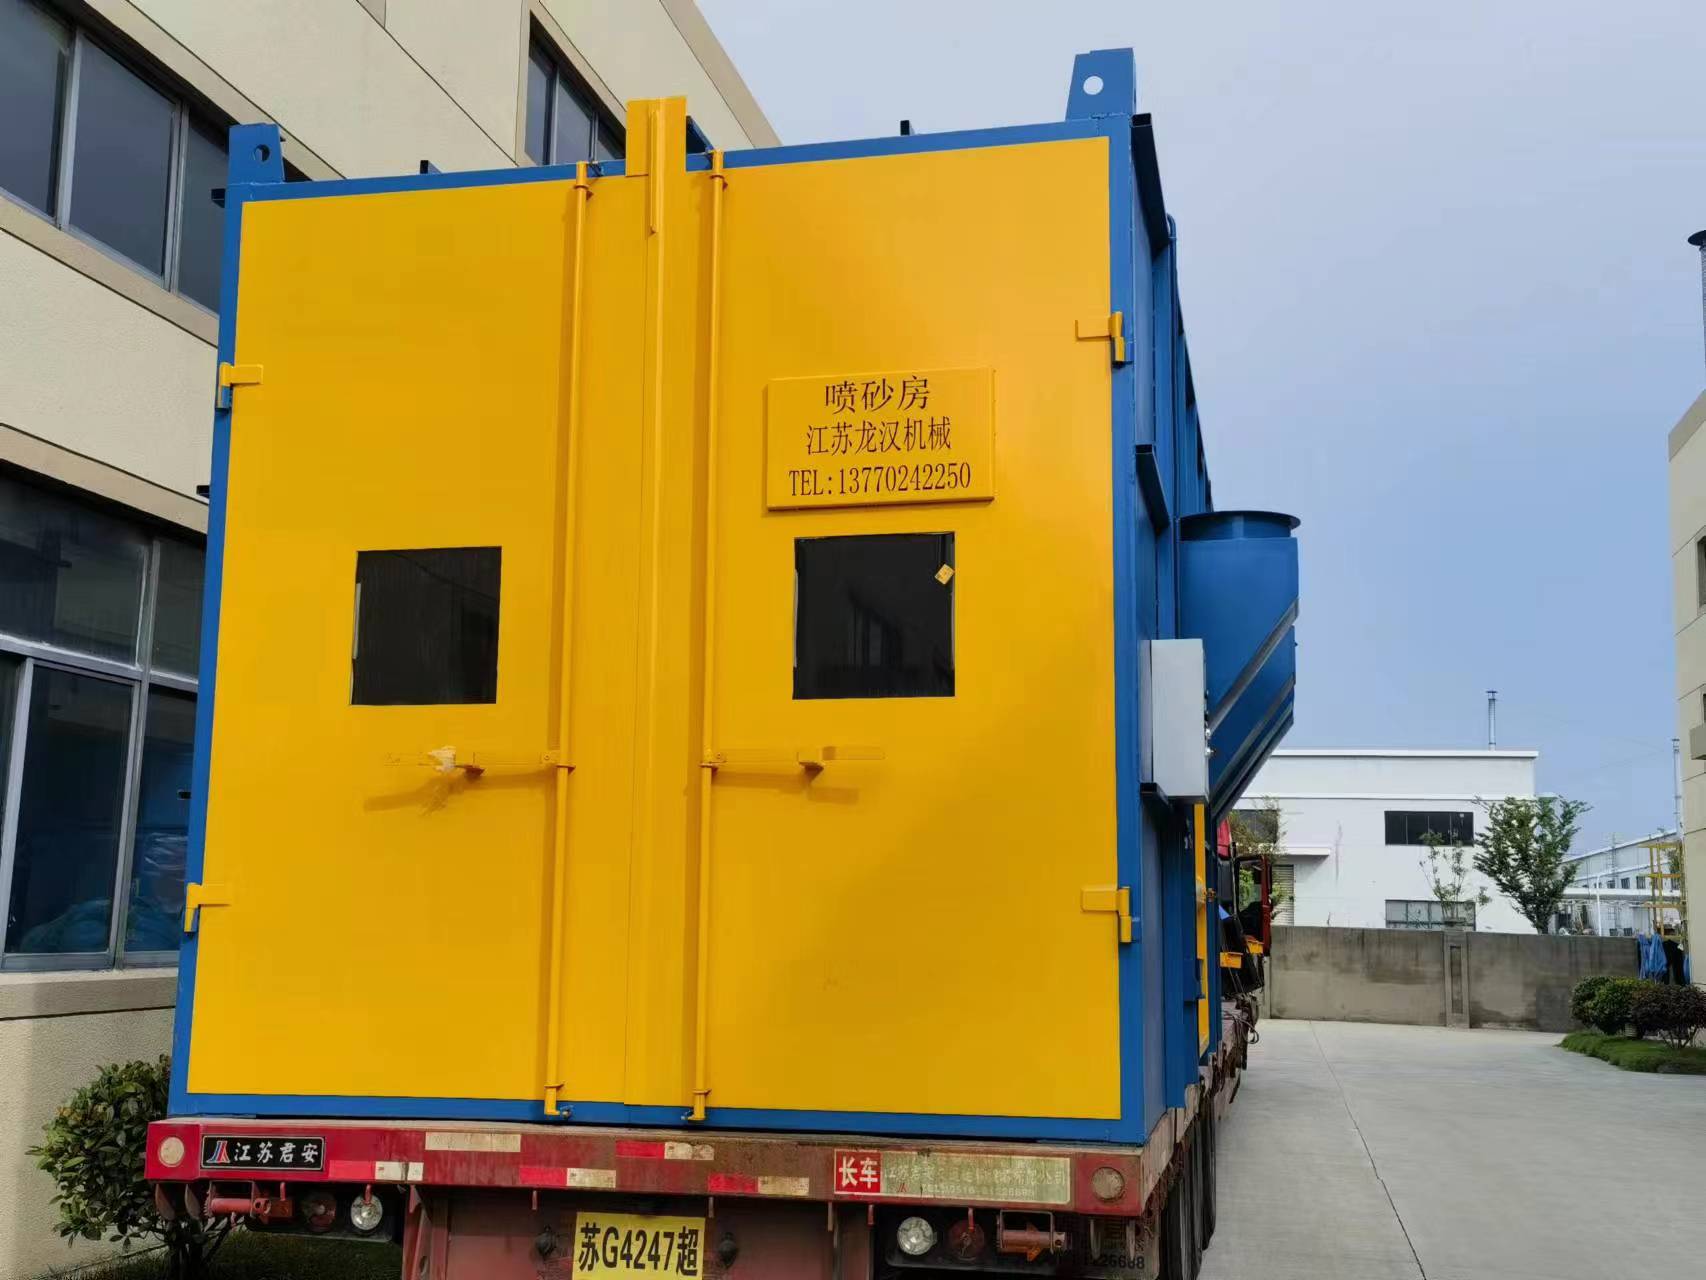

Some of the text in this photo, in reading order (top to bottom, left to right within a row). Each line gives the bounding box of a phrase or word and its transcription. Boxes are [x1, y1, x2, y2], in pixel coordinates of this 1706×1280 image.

[825, 375, 930, 415] 喷砂房
[806, 416, 952, 456] 江苏龙汉机械
[789, 462, 972, 497] TEL:13770242250
[234, 1141, 319, 1164] 江苏君安
[839, 1156, 879, 1189] 长车
[578, 1222, 700, 1276] 苏G4247超
